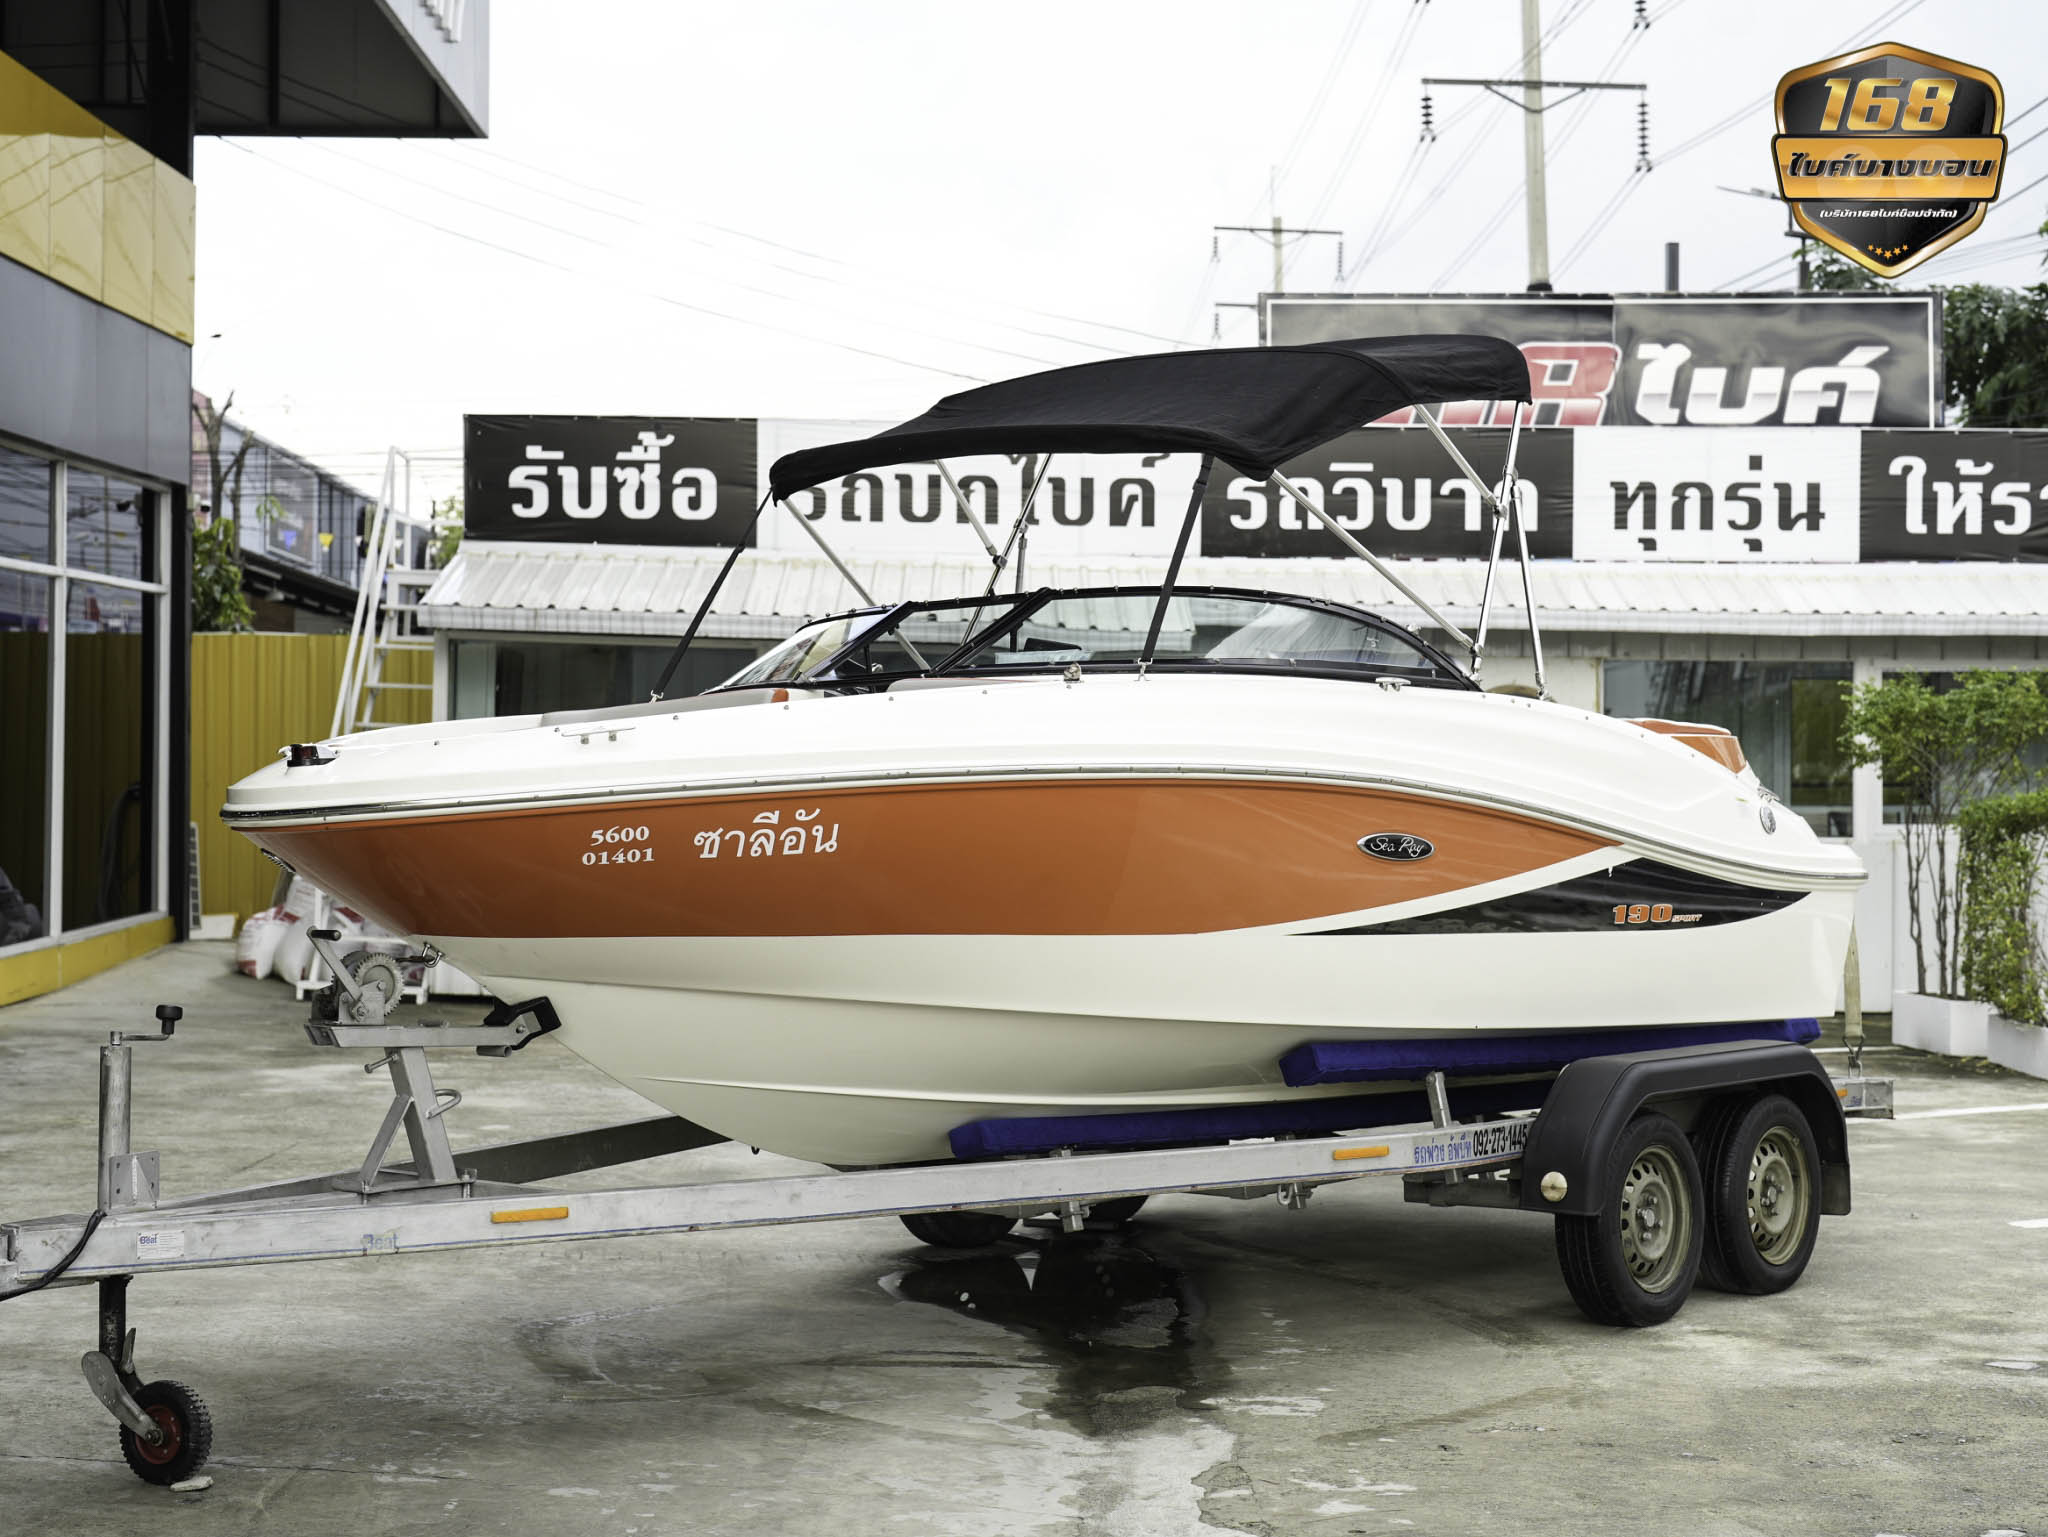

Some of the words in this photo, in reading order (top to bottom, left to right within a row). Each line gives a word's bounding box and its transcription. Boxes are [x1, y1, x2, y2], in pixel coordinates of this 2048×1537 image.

[1636, 343, 1891, 425] ไบค์
[508, 431, 718, 520] รับซื้อ
[1226, 462, 1538, 531] รถวิบาก
[1888, 455, 2048, 535] ให้ร
[1609, 454, 1826, 551] ทุกรุ่น
[582, 847, 655, 866] 01401
[590, 825, 650, 846] 5600
[693, 808, 839, 859] ซาลีอัน
[1370, 837, 1395, 852] Sea
[1398, 836, 1424, 858] Ray
[1612, 903, 1673, 925] 190
[1671, 913, 1702, 923] SPORT
[1472, 1124, 1527, 1157] 092-273-1445
